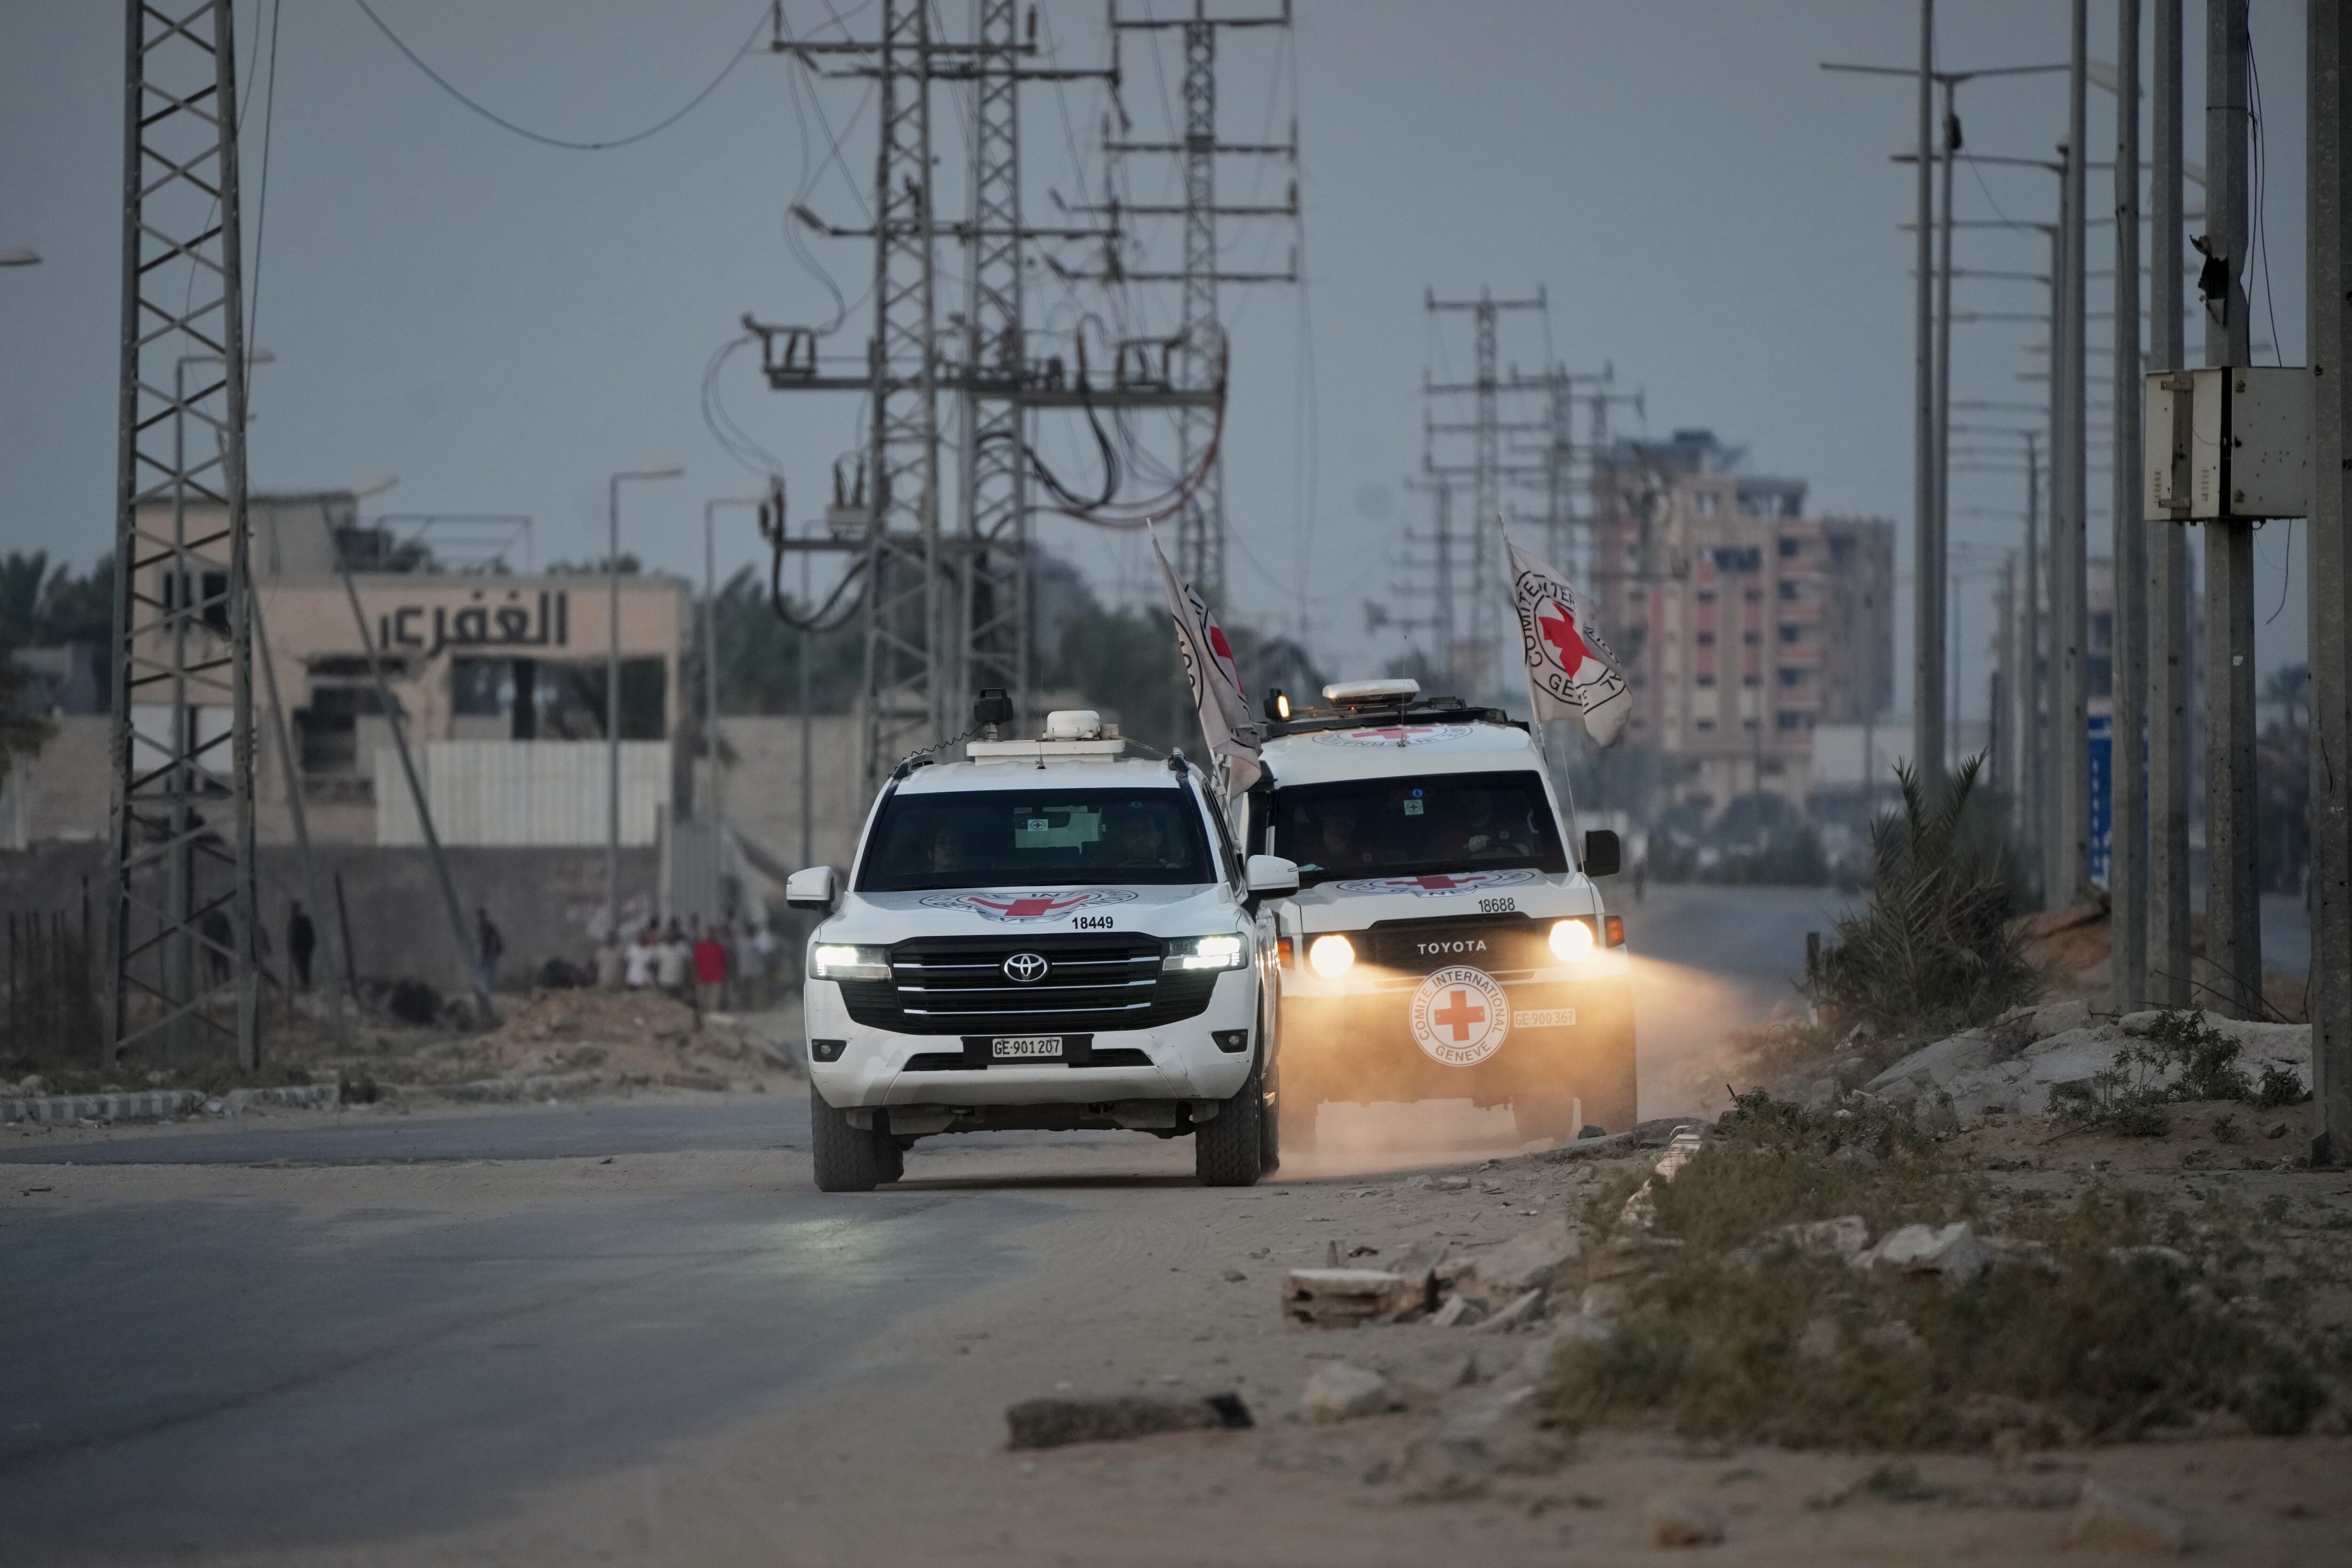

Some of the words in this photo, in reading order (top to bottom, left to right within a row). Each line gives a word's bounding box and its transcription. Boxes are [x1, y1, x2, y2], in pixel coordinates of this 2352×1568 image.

[1478, 897, 1515, 913] 18688
[1072, 916, 1113, 929] 18449
[1417, 940, 1487, 955] TOYOTA
[1414, 987, 1432, 1041] COMITE
[1432, 971, 1505, 1033] INTERNATIONAL
[1436, 1041, 1491, 1061] GENEVE
